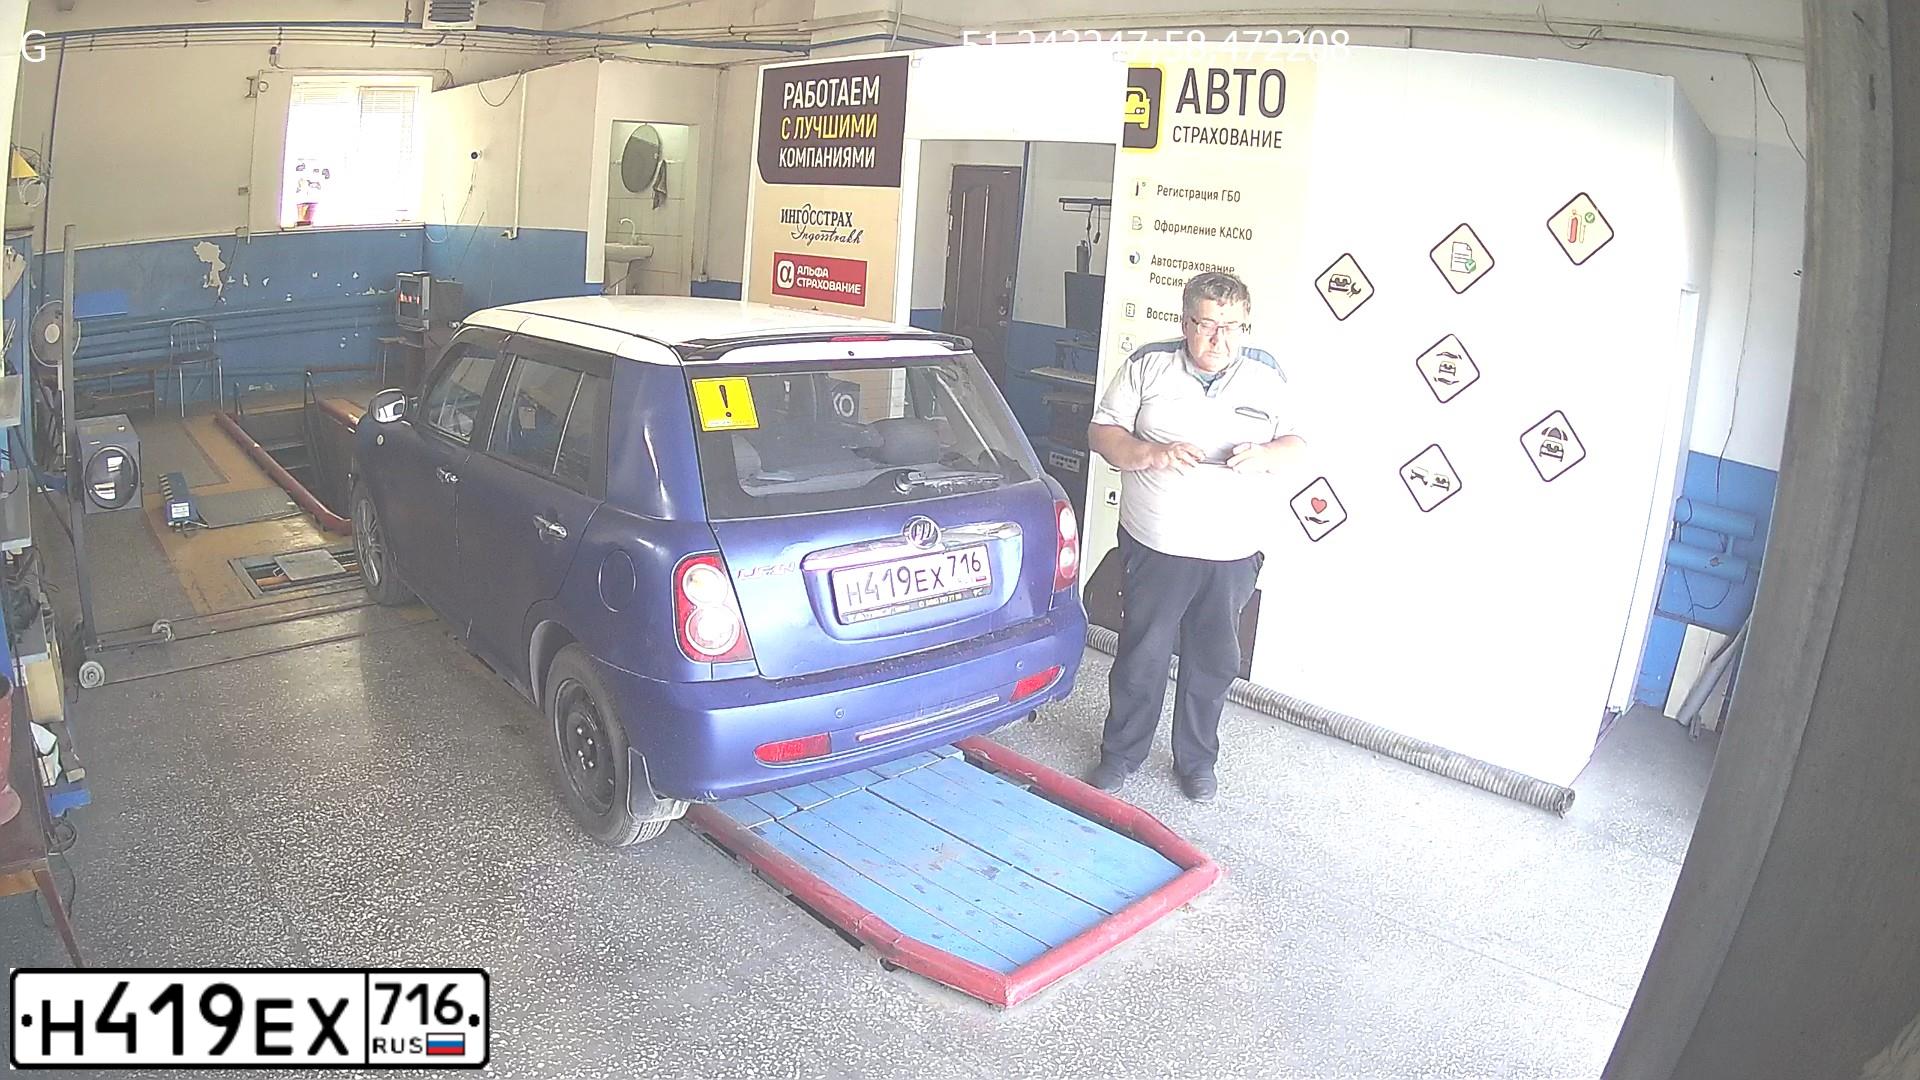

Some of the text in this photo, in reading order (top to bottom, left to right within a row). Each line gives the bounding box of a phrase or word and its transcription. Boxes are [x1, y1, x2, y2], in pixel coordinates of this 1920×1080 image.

[783, 75, 880, 110] РАБОТАЕМ
[1175, 67, 1287, 119] АВТО
[781, 113, 878, 140] С ЛУЧШИМИ
[1172, 125, 1283, 149] СТРАХОВАНИЕ
[778, 146, 876, 168] КОМПАНИЯМИ
[1156, 184, 1241, 203] Регистрация ГБО
[780, 204, 853, 227] ИНГОССТРАХ
[1153, 219, 1253, 241] Оформление КАСКО
[796, 265, 829, 279] АЛЬФА
[796, 277, 862, 295] СТРАХОВАНИЕ
[946, 551, 982, 577] 716
